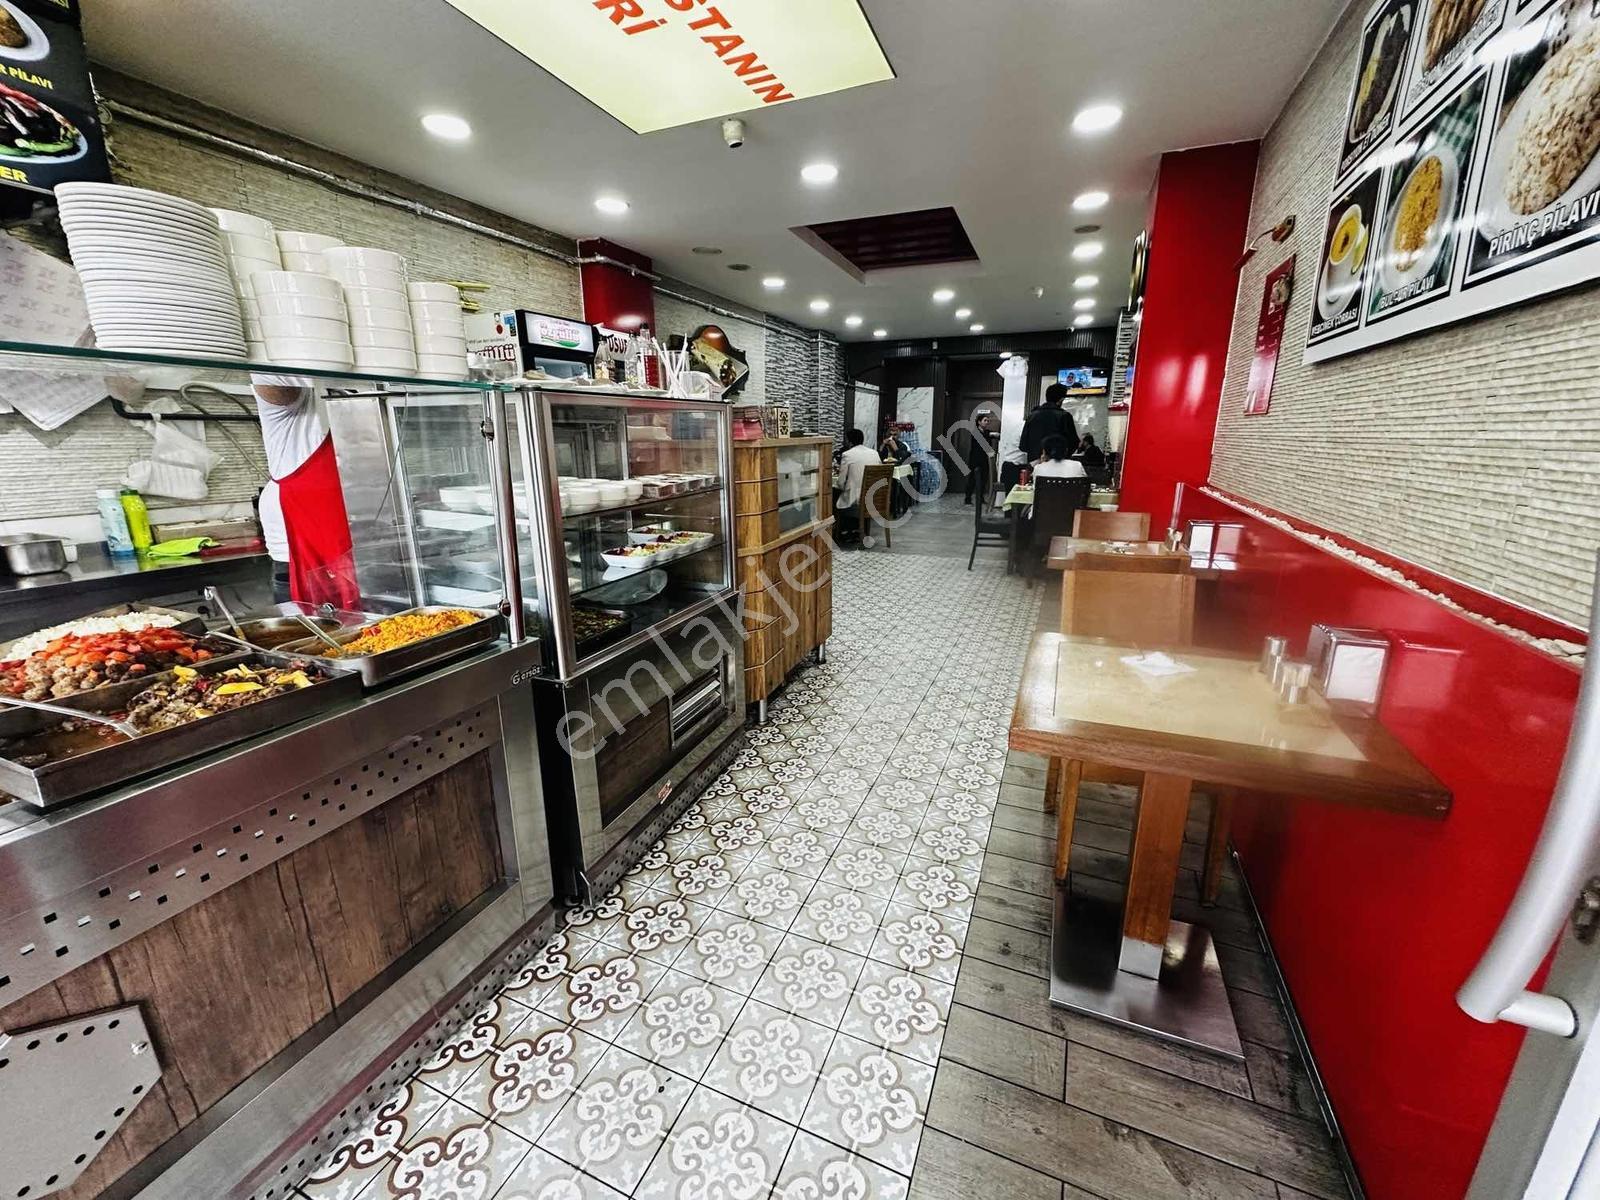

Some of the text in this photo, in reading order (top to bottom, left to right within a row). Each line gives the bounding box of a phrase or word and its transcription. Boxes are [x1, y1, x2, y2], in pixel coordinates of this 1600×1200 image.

[8, 66, 54, 90] PİLAVI
[1488, 190, 1600, 259] PİRİNÇ PİLAVI
